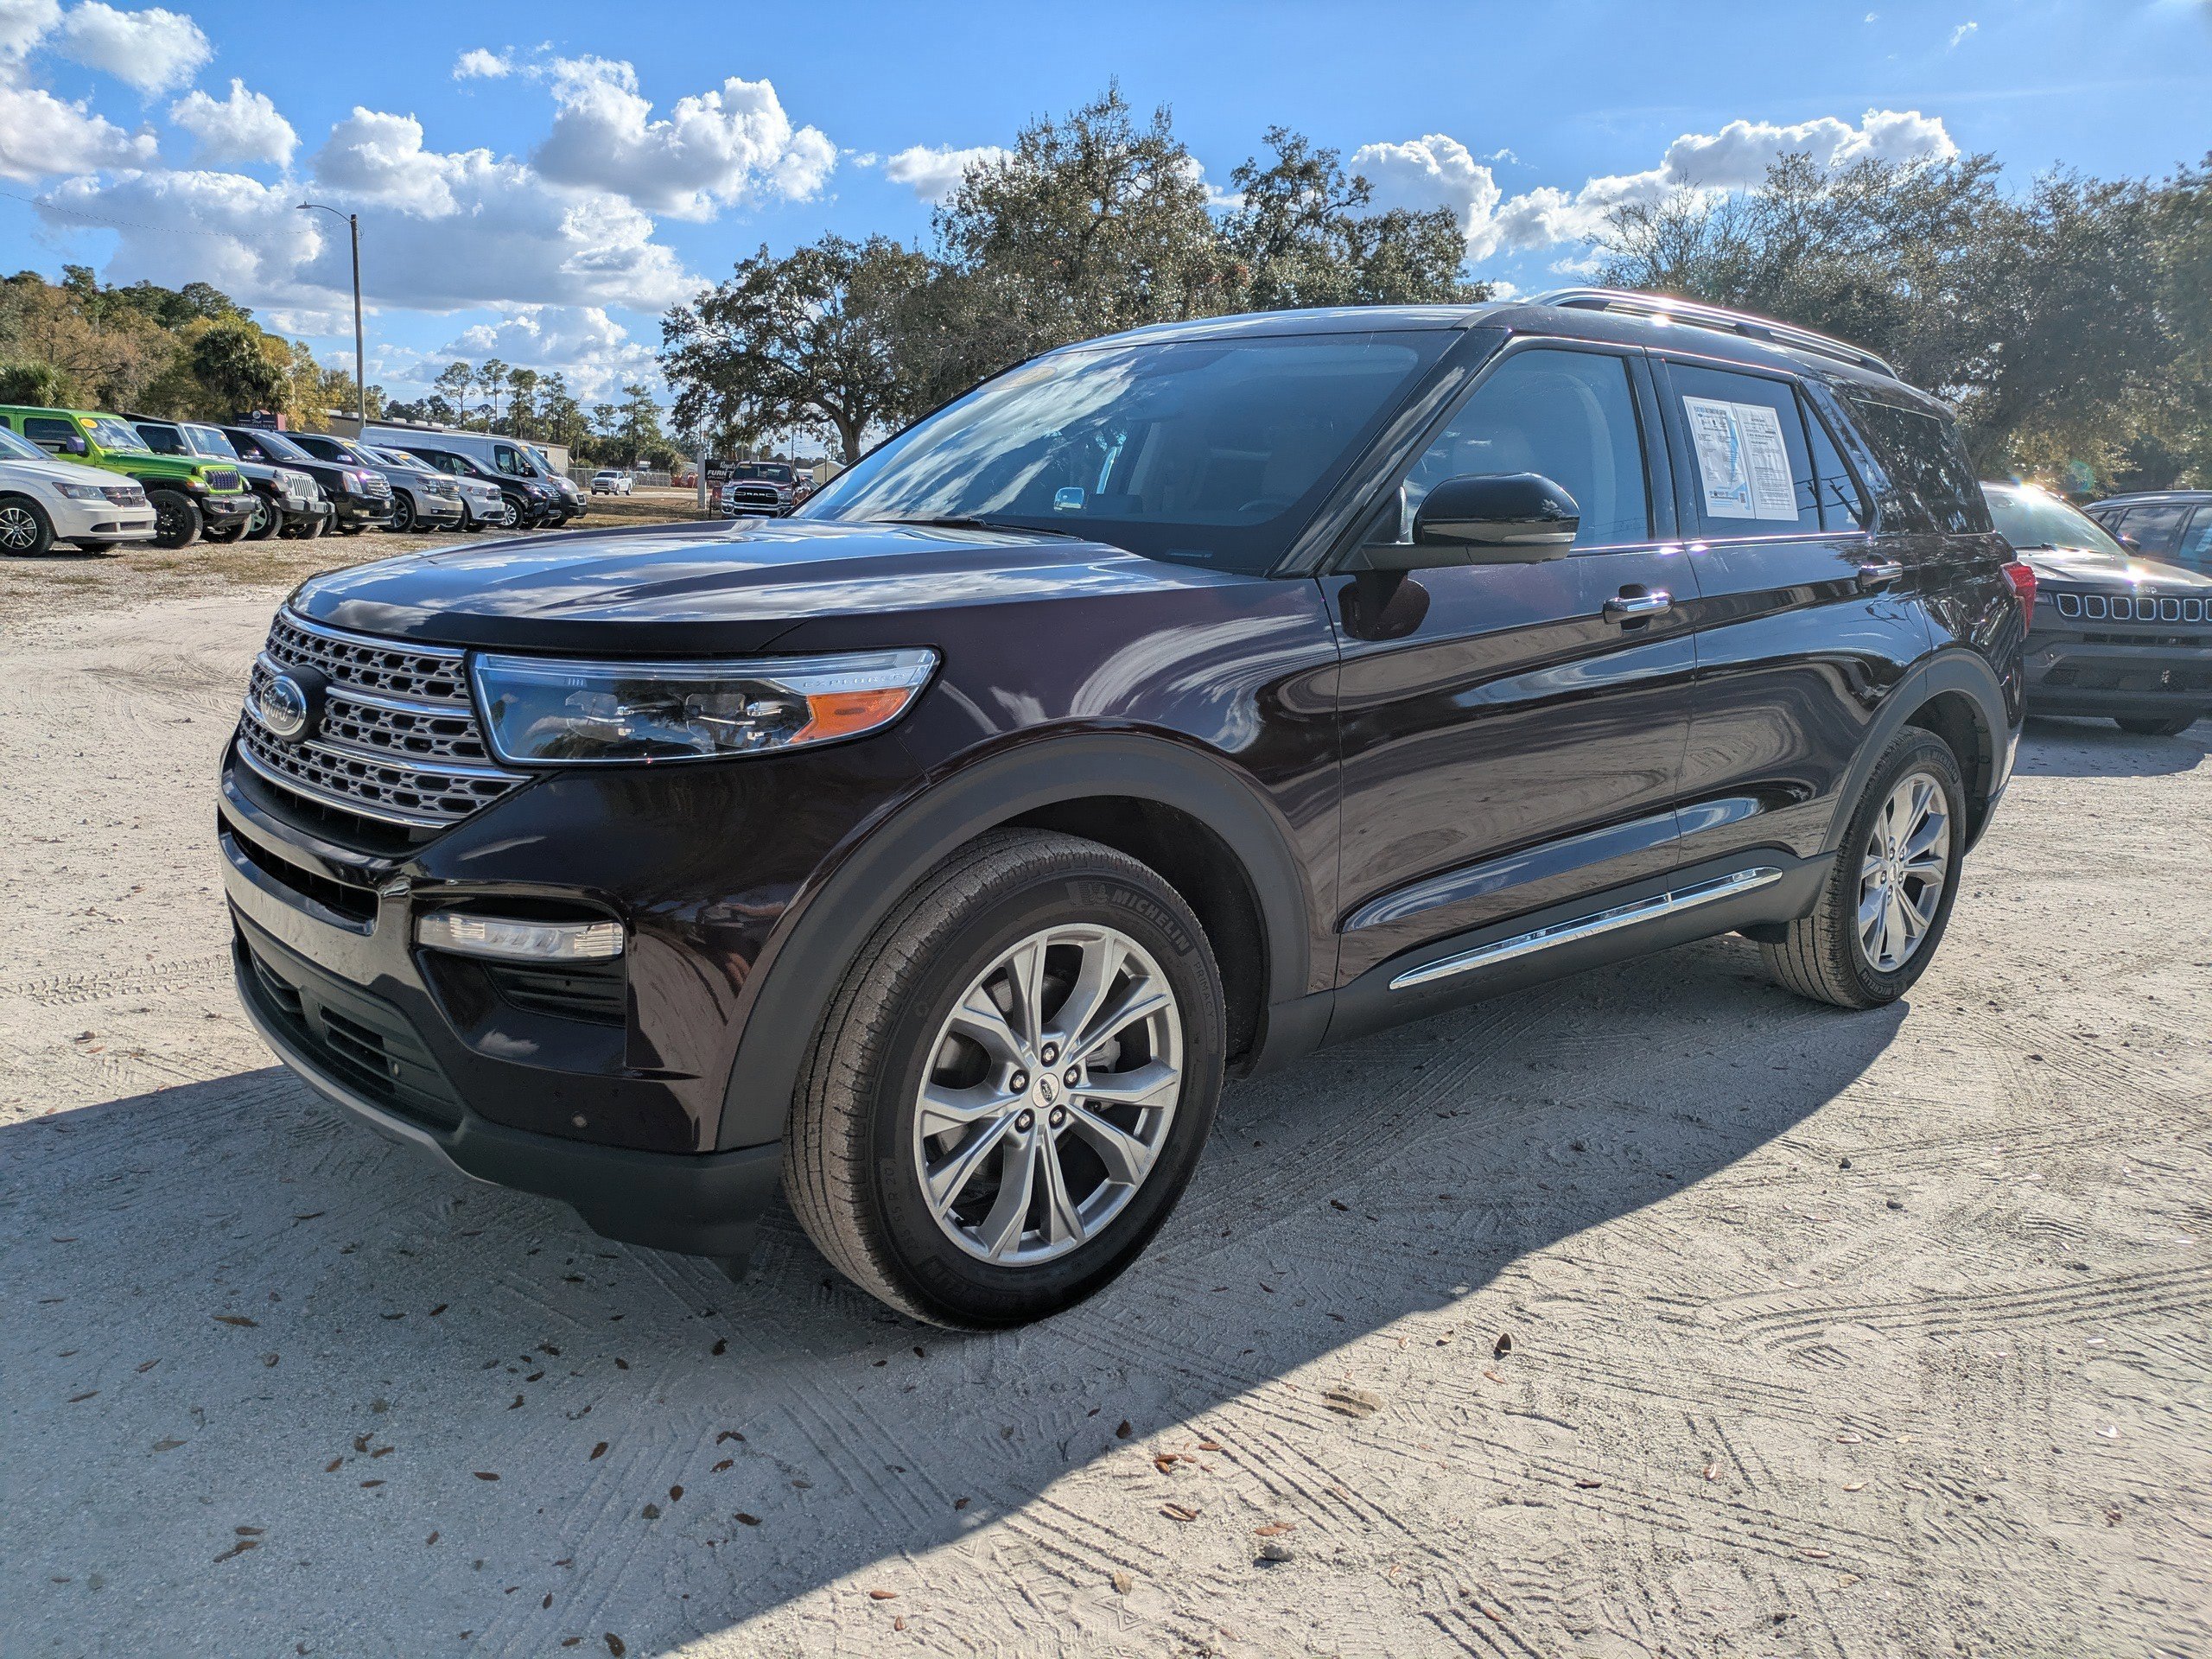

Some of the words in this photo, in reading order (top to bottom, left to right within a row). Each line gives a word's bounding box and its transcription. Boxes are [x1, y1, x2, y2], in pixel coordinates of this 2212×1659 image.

[2132, 584, 2157, 594] Jeep
[1932, 750, 1958, 781] MICHELIN
[1111, 888, 1190, 951] MICHELIN
[1193, 962, 1215, 1019] PRIMACY
[1860, 969, 1893, 995] MICHELIN
